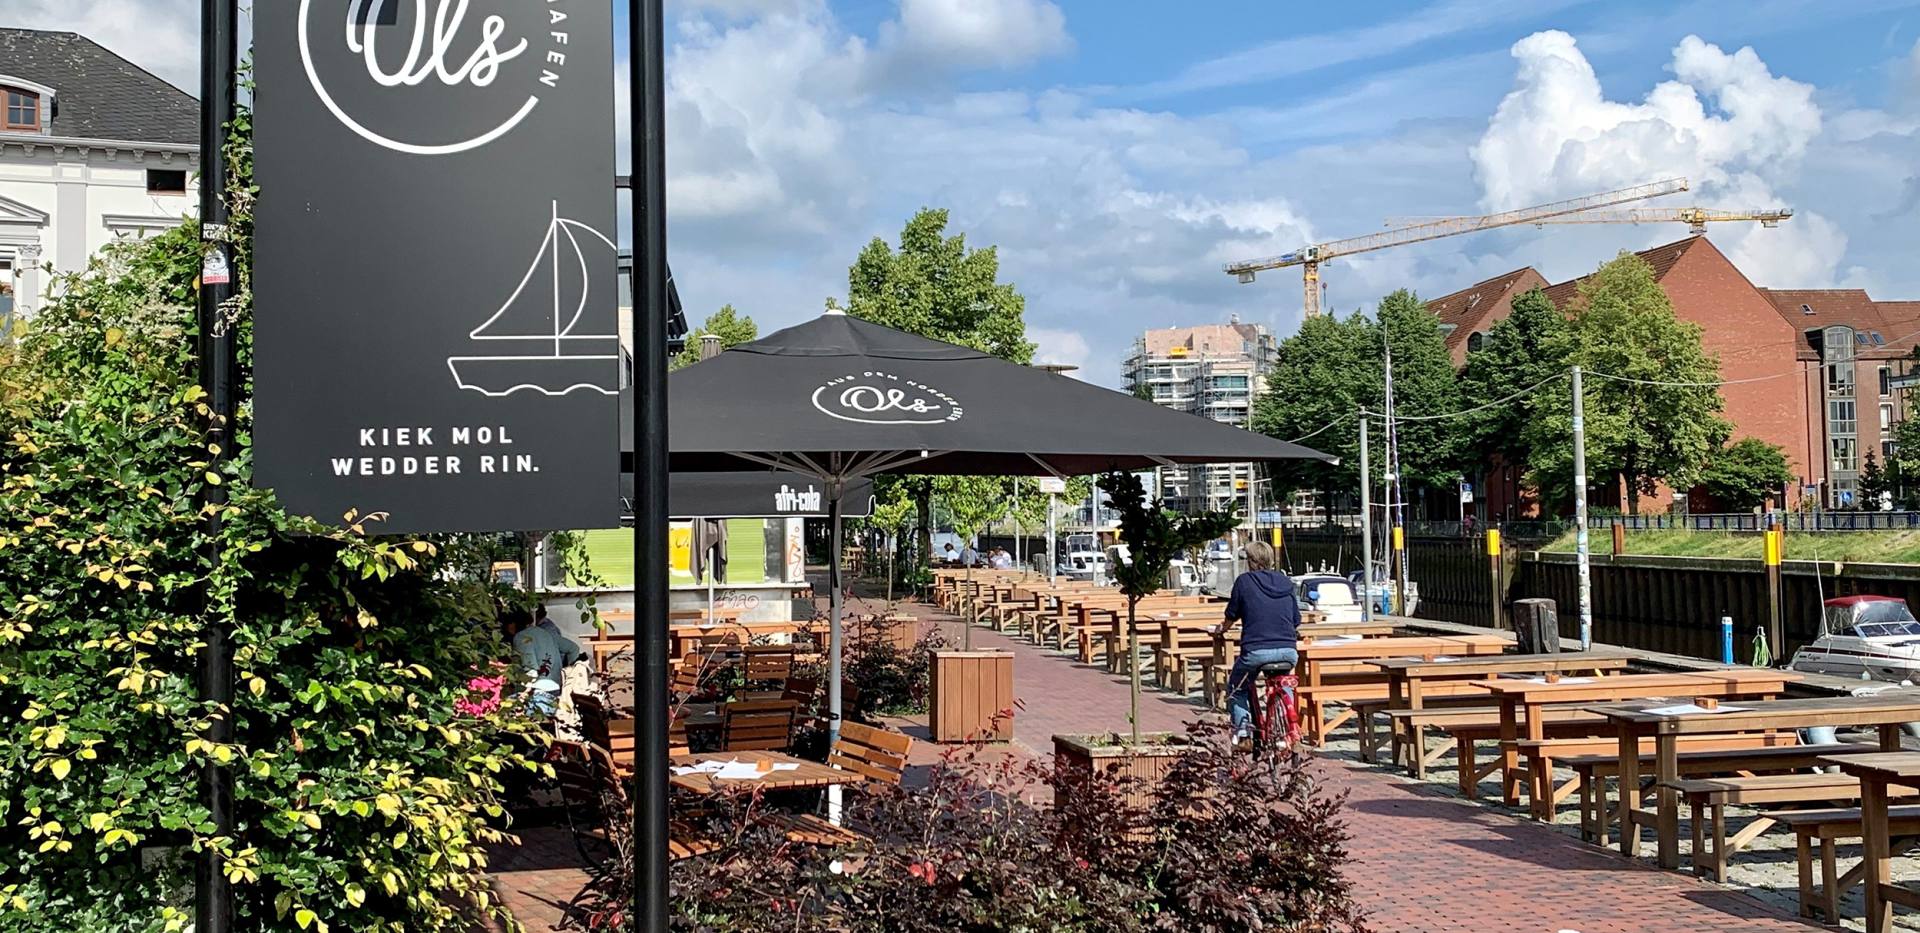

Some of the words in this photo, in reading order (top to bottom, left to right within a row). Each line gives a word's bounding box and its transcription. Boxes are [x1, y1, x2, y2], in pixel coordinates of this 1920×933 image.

[539, 0, 569, 88] AFEN
[840, 385, 941, 413] Ols
[360, 427, 433, 446] KIEK
[452, 426, 513, 445] MOL
[331, 456, 461, 476] WEDDER
[480, 454, 539, 473] RIN.
[774, 484, 821, 512] afri-cola
